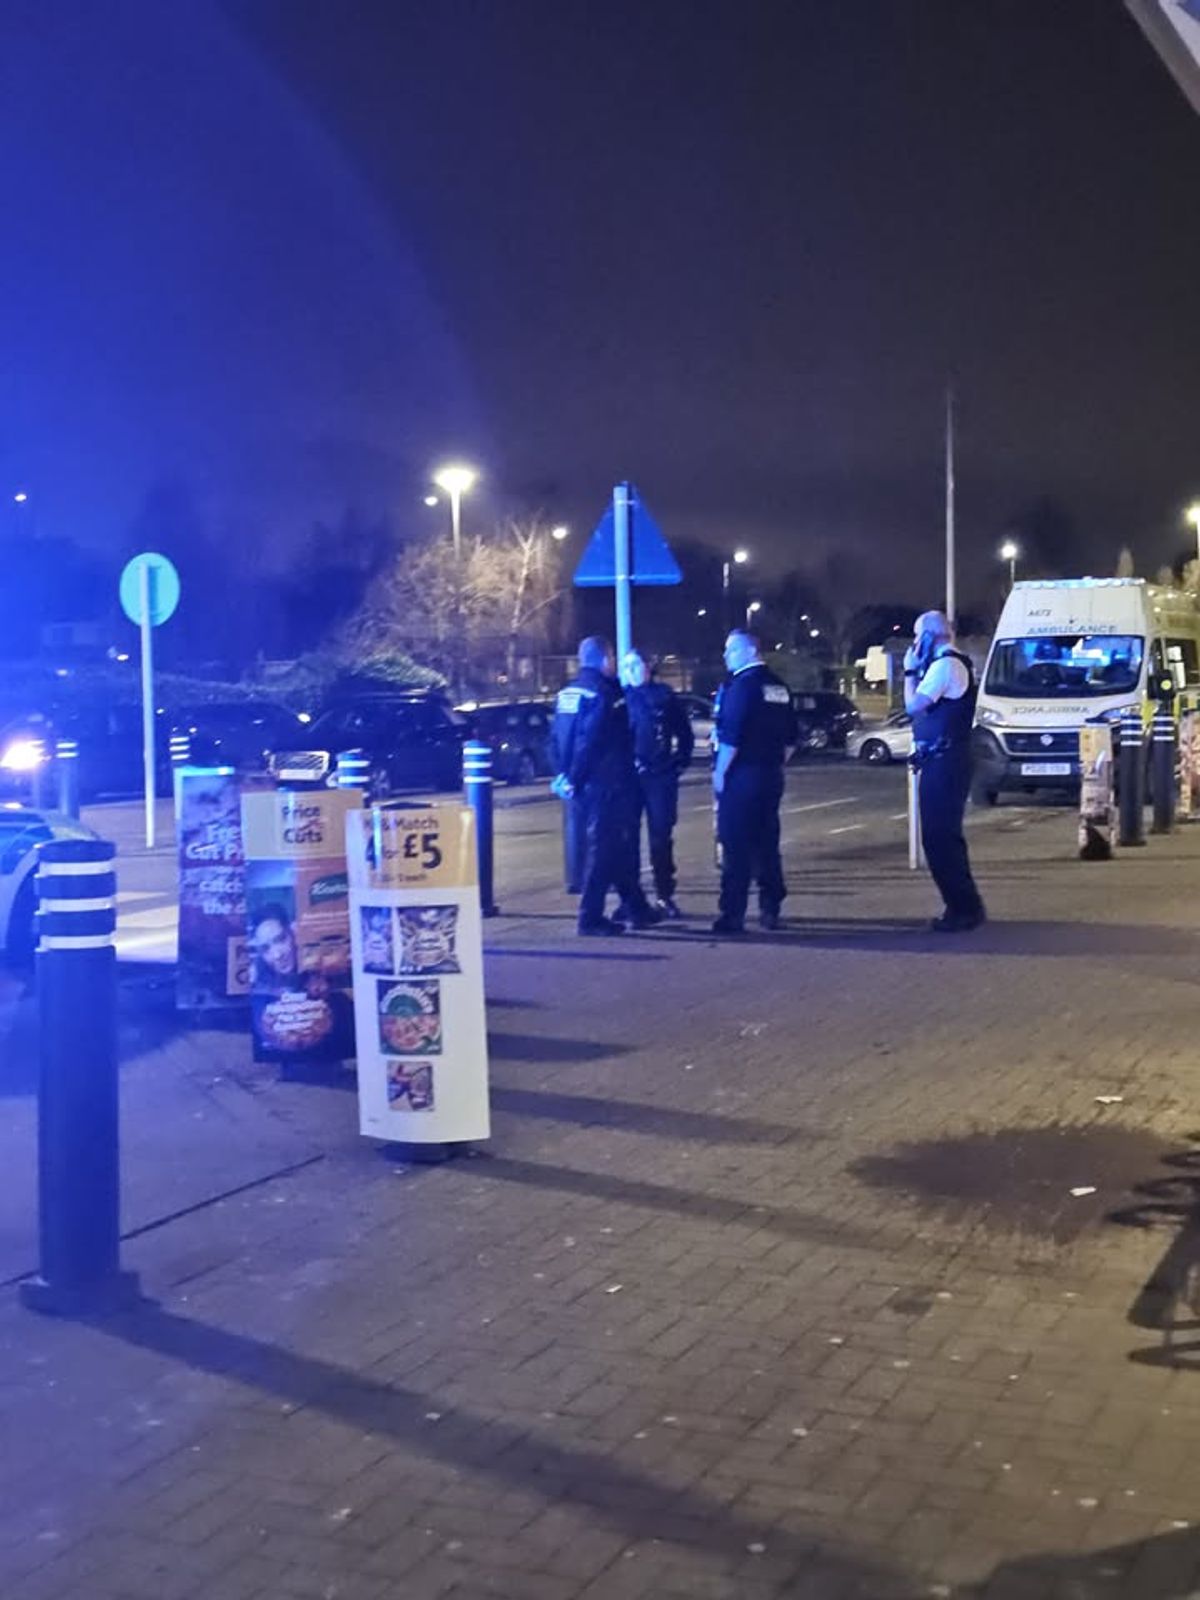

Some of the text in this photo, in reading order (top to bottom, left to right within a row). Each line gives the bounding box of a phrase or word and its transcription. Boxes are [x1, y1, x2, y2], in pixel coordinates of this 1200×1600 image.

[1027, 625, 1117, 635] AMBULANCE
[282, 803, 321, 820] Price
[283, 828, 323, 844] Cuts
[403, 832, 442, 869] £5
